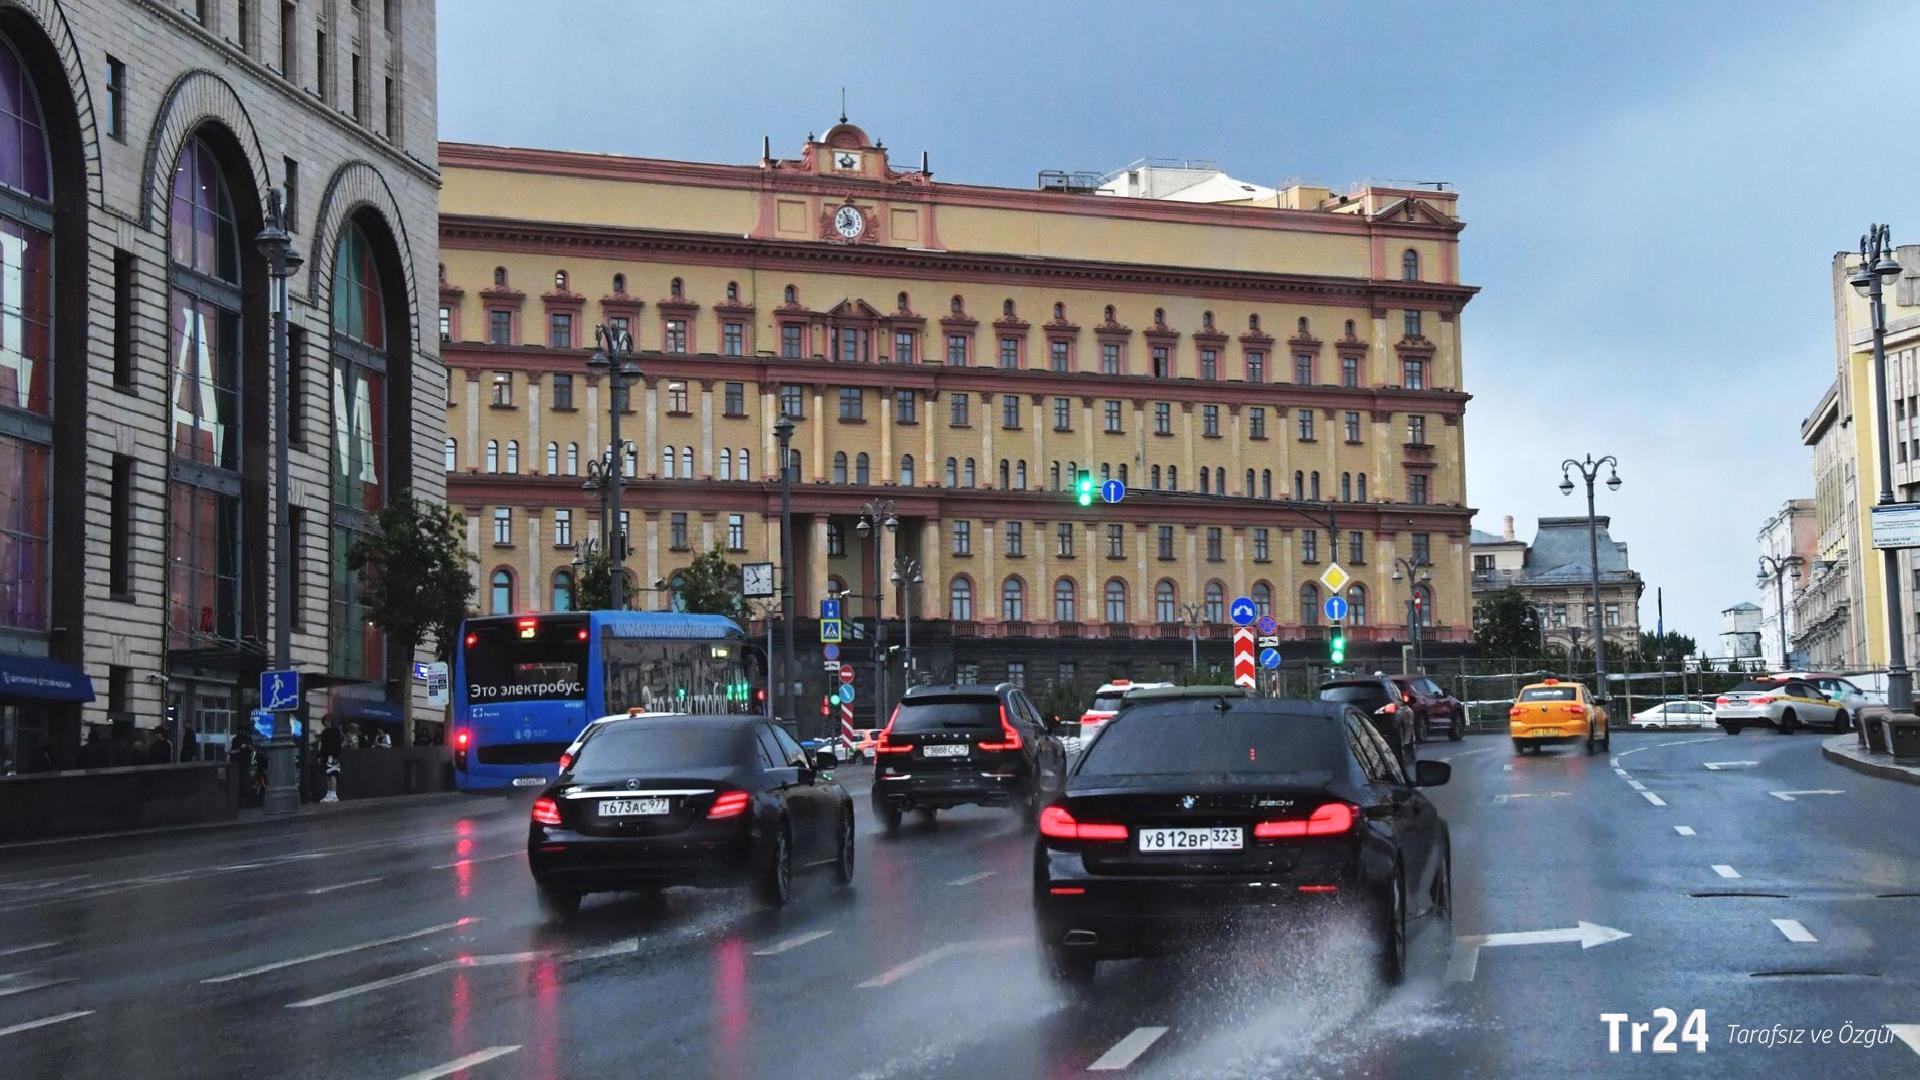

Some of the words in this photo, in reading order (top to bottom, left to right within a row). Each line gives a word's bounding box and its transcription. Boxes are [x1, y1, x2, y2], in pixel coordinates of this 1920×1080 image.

[470, 684, 497, 698] Это
[500, 680, 585, 697] электробус.
[1213, 829, 1238, 842] 323
